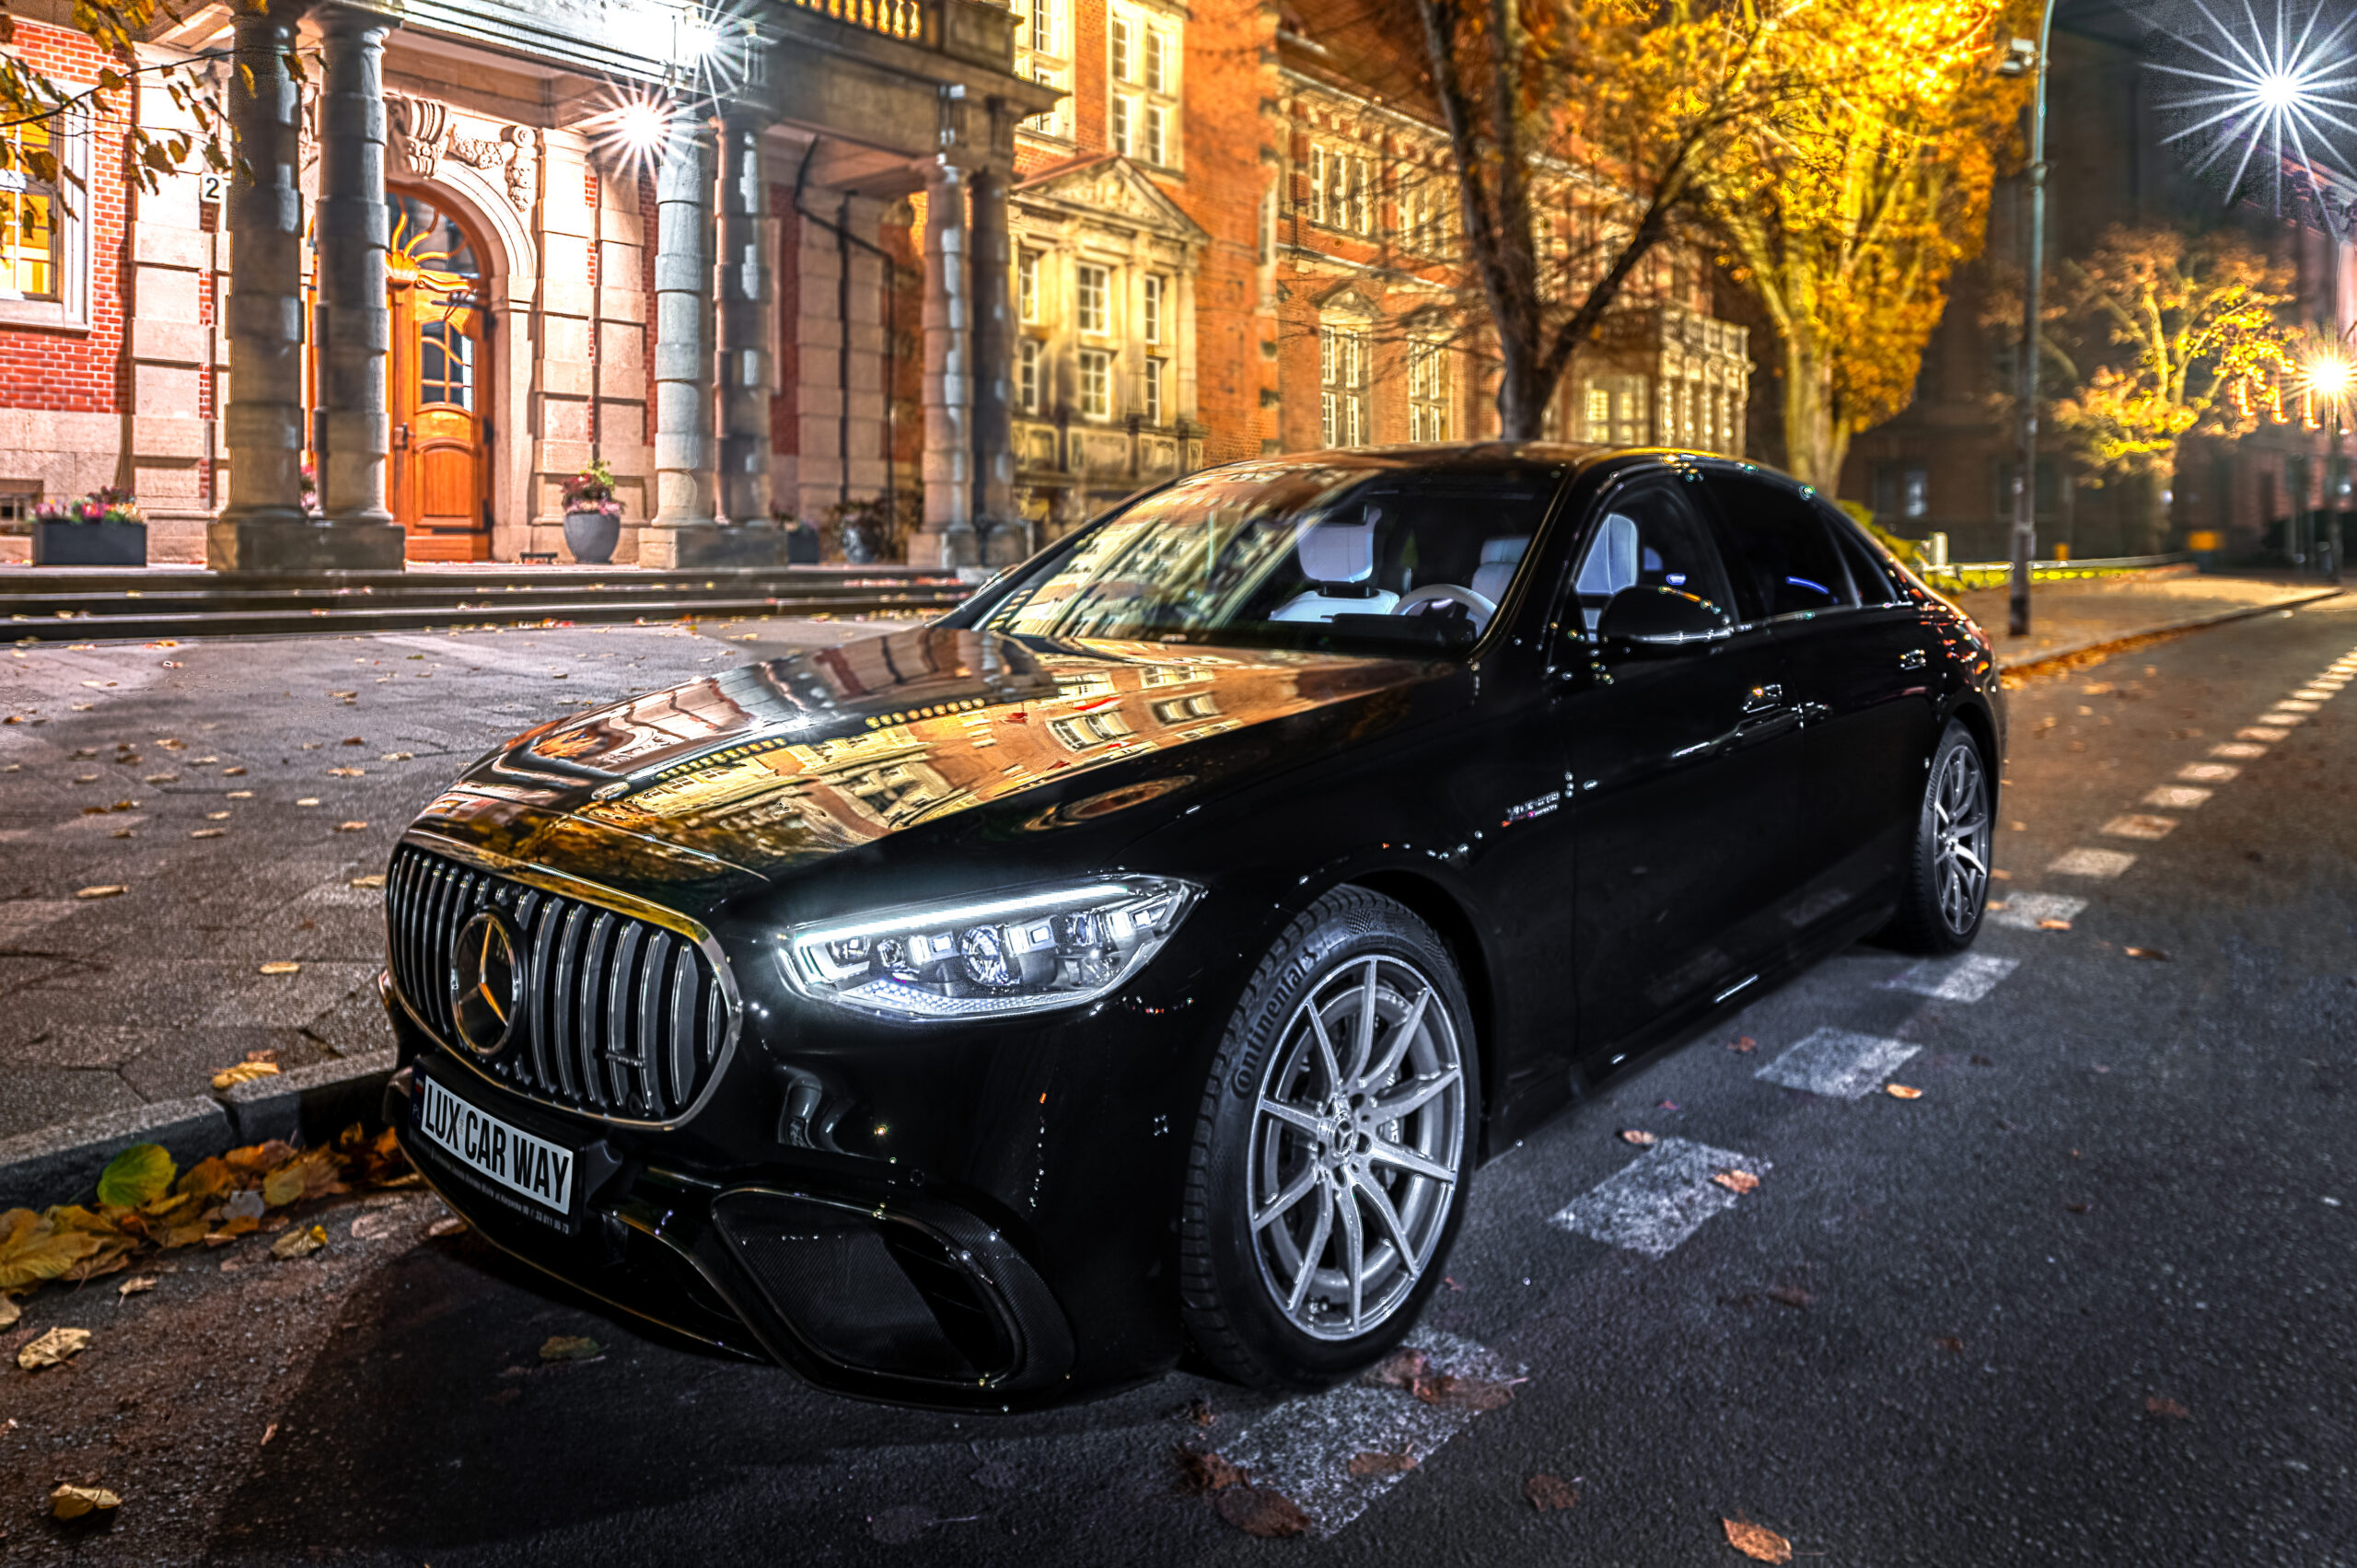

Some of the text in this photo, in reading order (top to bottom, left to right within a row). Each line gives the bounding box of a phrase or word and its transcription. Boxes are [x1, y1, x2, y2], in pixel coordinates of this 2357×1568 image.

[206, 178, 220, 199] 2
[1231, 958, 1307, 1099] Continental
[425, 1084, 462, 1150] LUX
[464, 1110, 506, 1178] CAR
[514, 1134, 569, 1203] WAY
